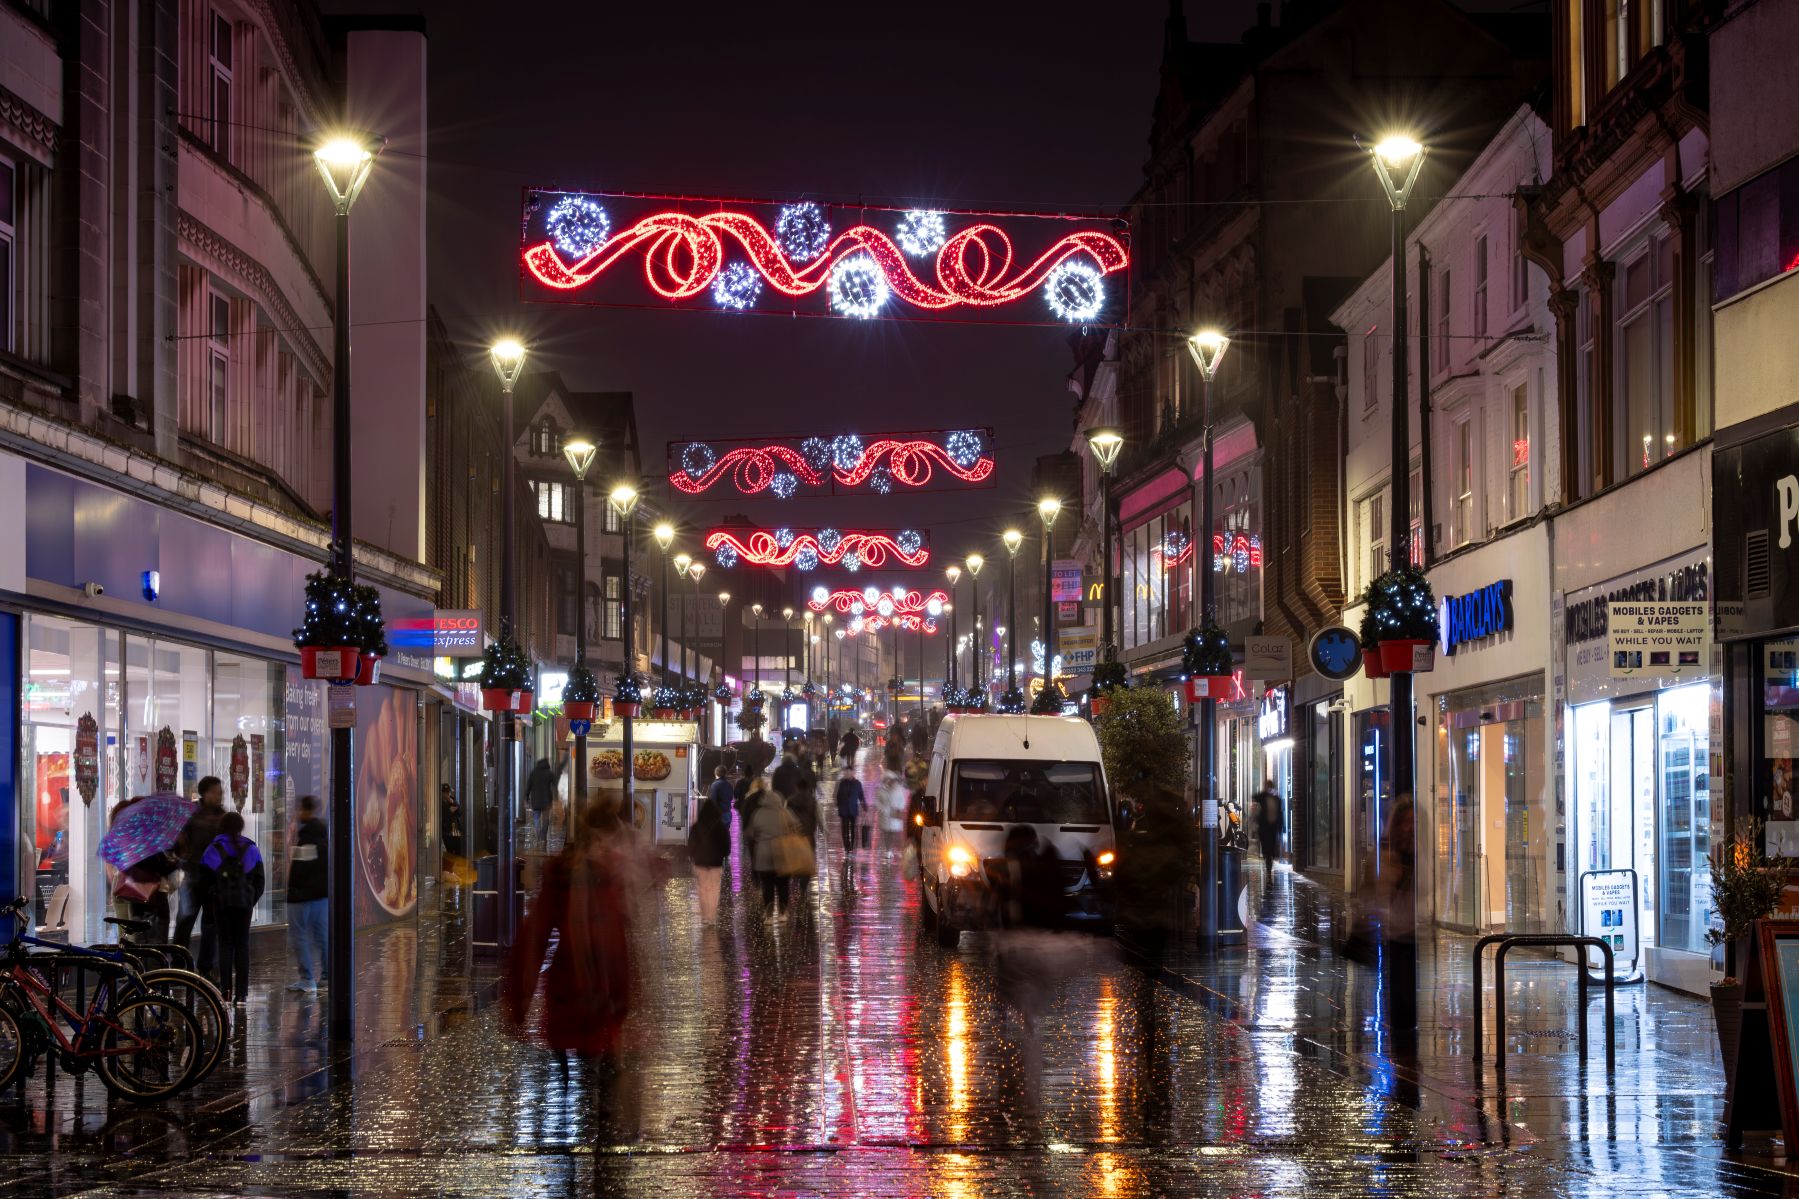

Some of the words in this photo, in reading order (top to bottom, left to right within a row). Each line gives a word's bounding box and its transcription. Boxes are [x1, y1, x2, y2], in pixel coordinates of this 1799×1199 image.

[1777, 474, 1799, 549] P
[1451, 579, 1510, 646] BARCLAYS
[1613, 606, 1655, 616] MOBILES
[1658, 606, 1703, 616] GADGETS
[434, 617, 478, 629] TESCO
[1637, 617, 1645, 625] &
[1647, 616, 1679, 625] VAPES
[434, 636, 476, 648] express
[1615, 637, 1648, 645] WHILE
[1651, 637, 1674, 645] YOU
[1675, 637, 1702, 645] WAIT
[1074, 650, 1094, 662] FHP
[1594, 646, 1604, 661] SELL
[286, 682, 304, 709] Baking
[300, 714, 310, 731] our
[301, 740, 311, 764] day
